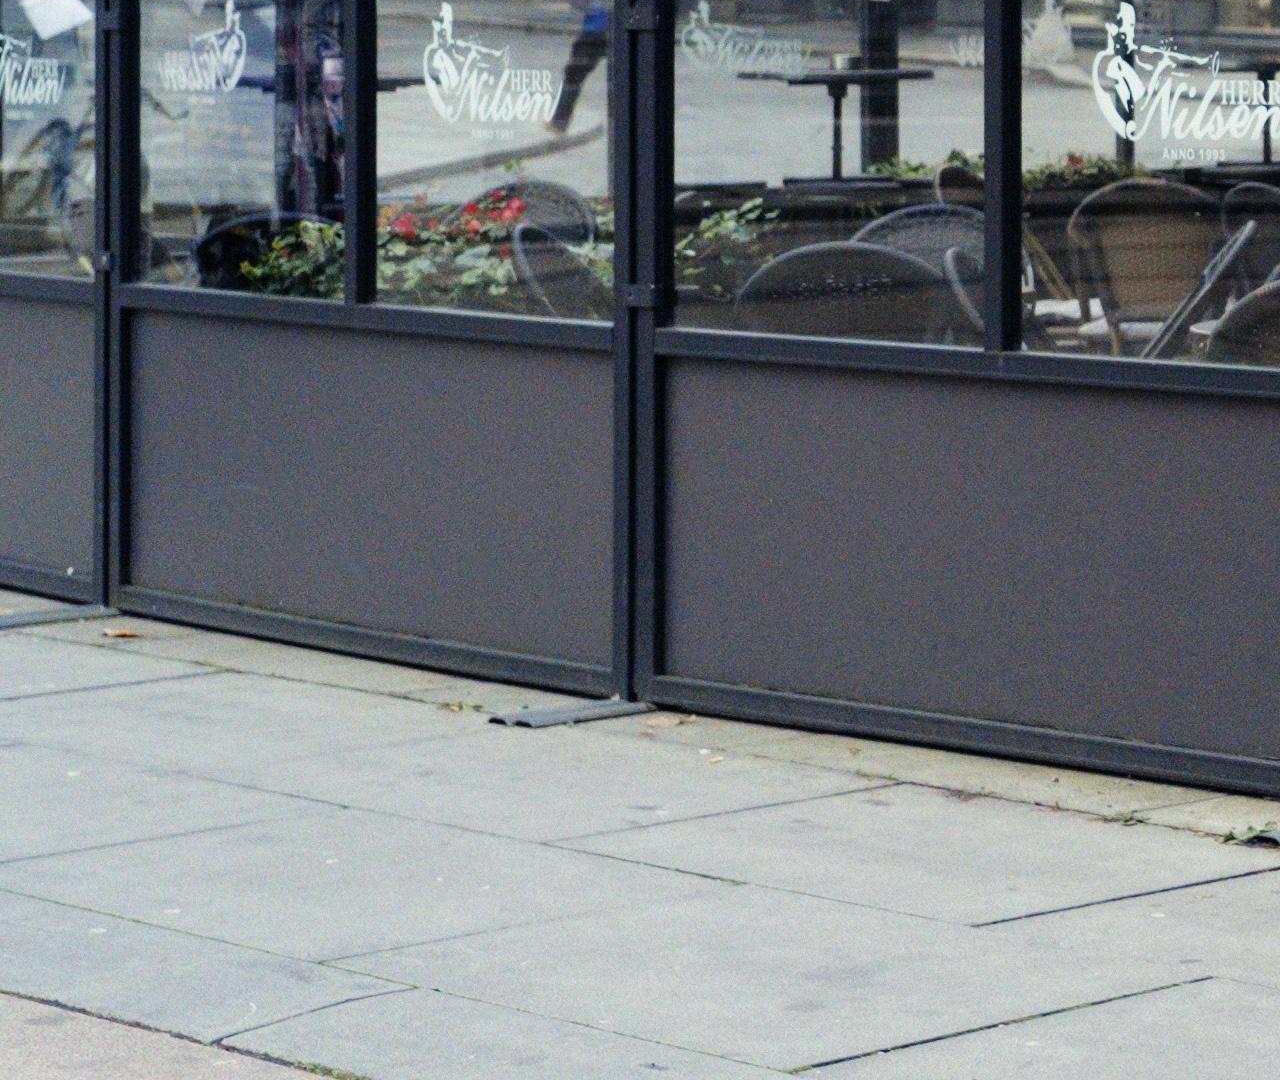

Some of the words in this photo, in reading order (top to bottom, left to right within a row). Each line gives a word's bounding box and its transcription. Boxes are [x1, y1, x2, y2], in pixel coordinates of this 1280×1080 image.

[510, 69, 553, 92] HERR
[446, 67, 564, 123] Nilsen
[1163, 147, 1196, 160] ANNO
[1199, 148, 1226, 161] 1993
